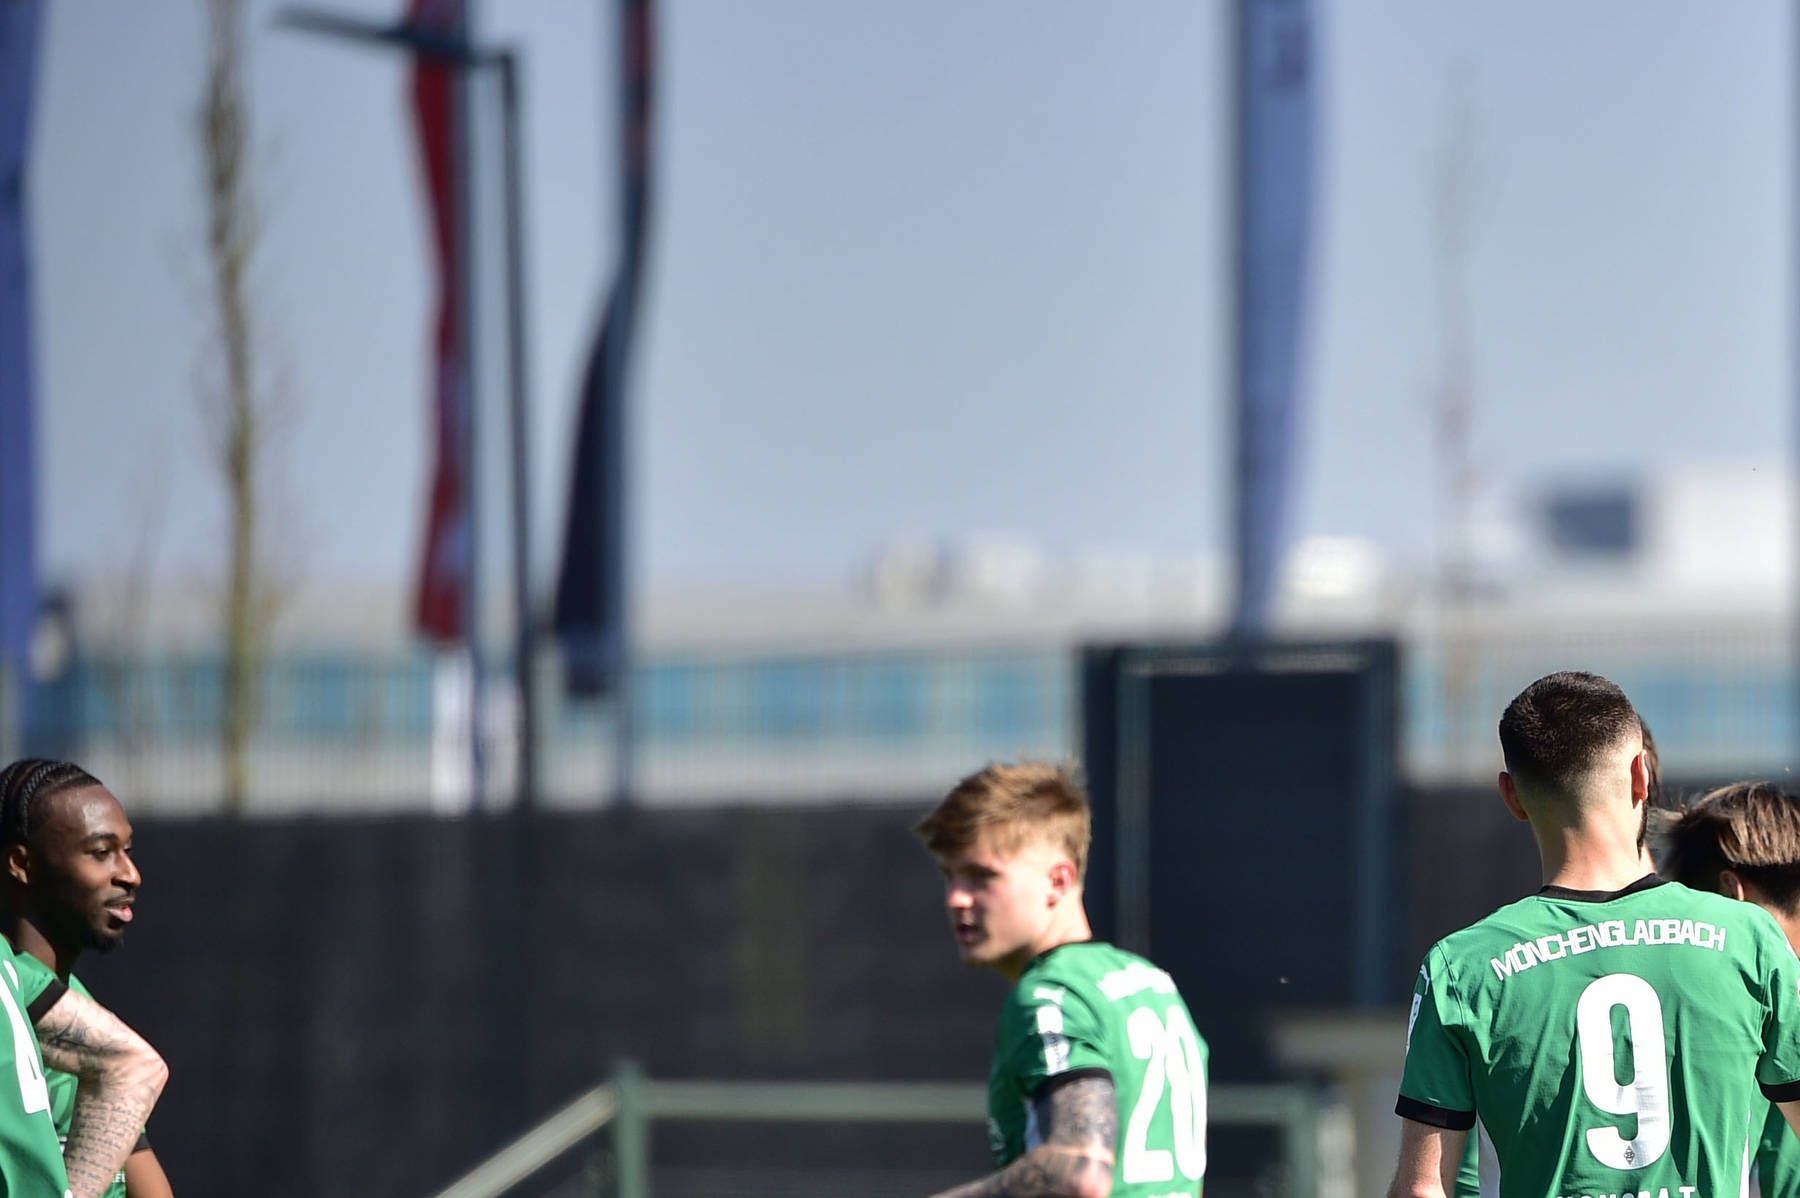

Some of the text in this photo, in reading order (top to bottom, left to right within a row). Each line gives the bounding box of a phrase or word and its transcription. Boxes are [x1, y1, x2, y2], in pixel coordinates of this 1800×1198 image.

[1490, 919, 1727, 981] MÖNCHENGLADBACH
[1122, 1004, 1208, 1184] 20
[1576, 972, 1671, 1171] 9
